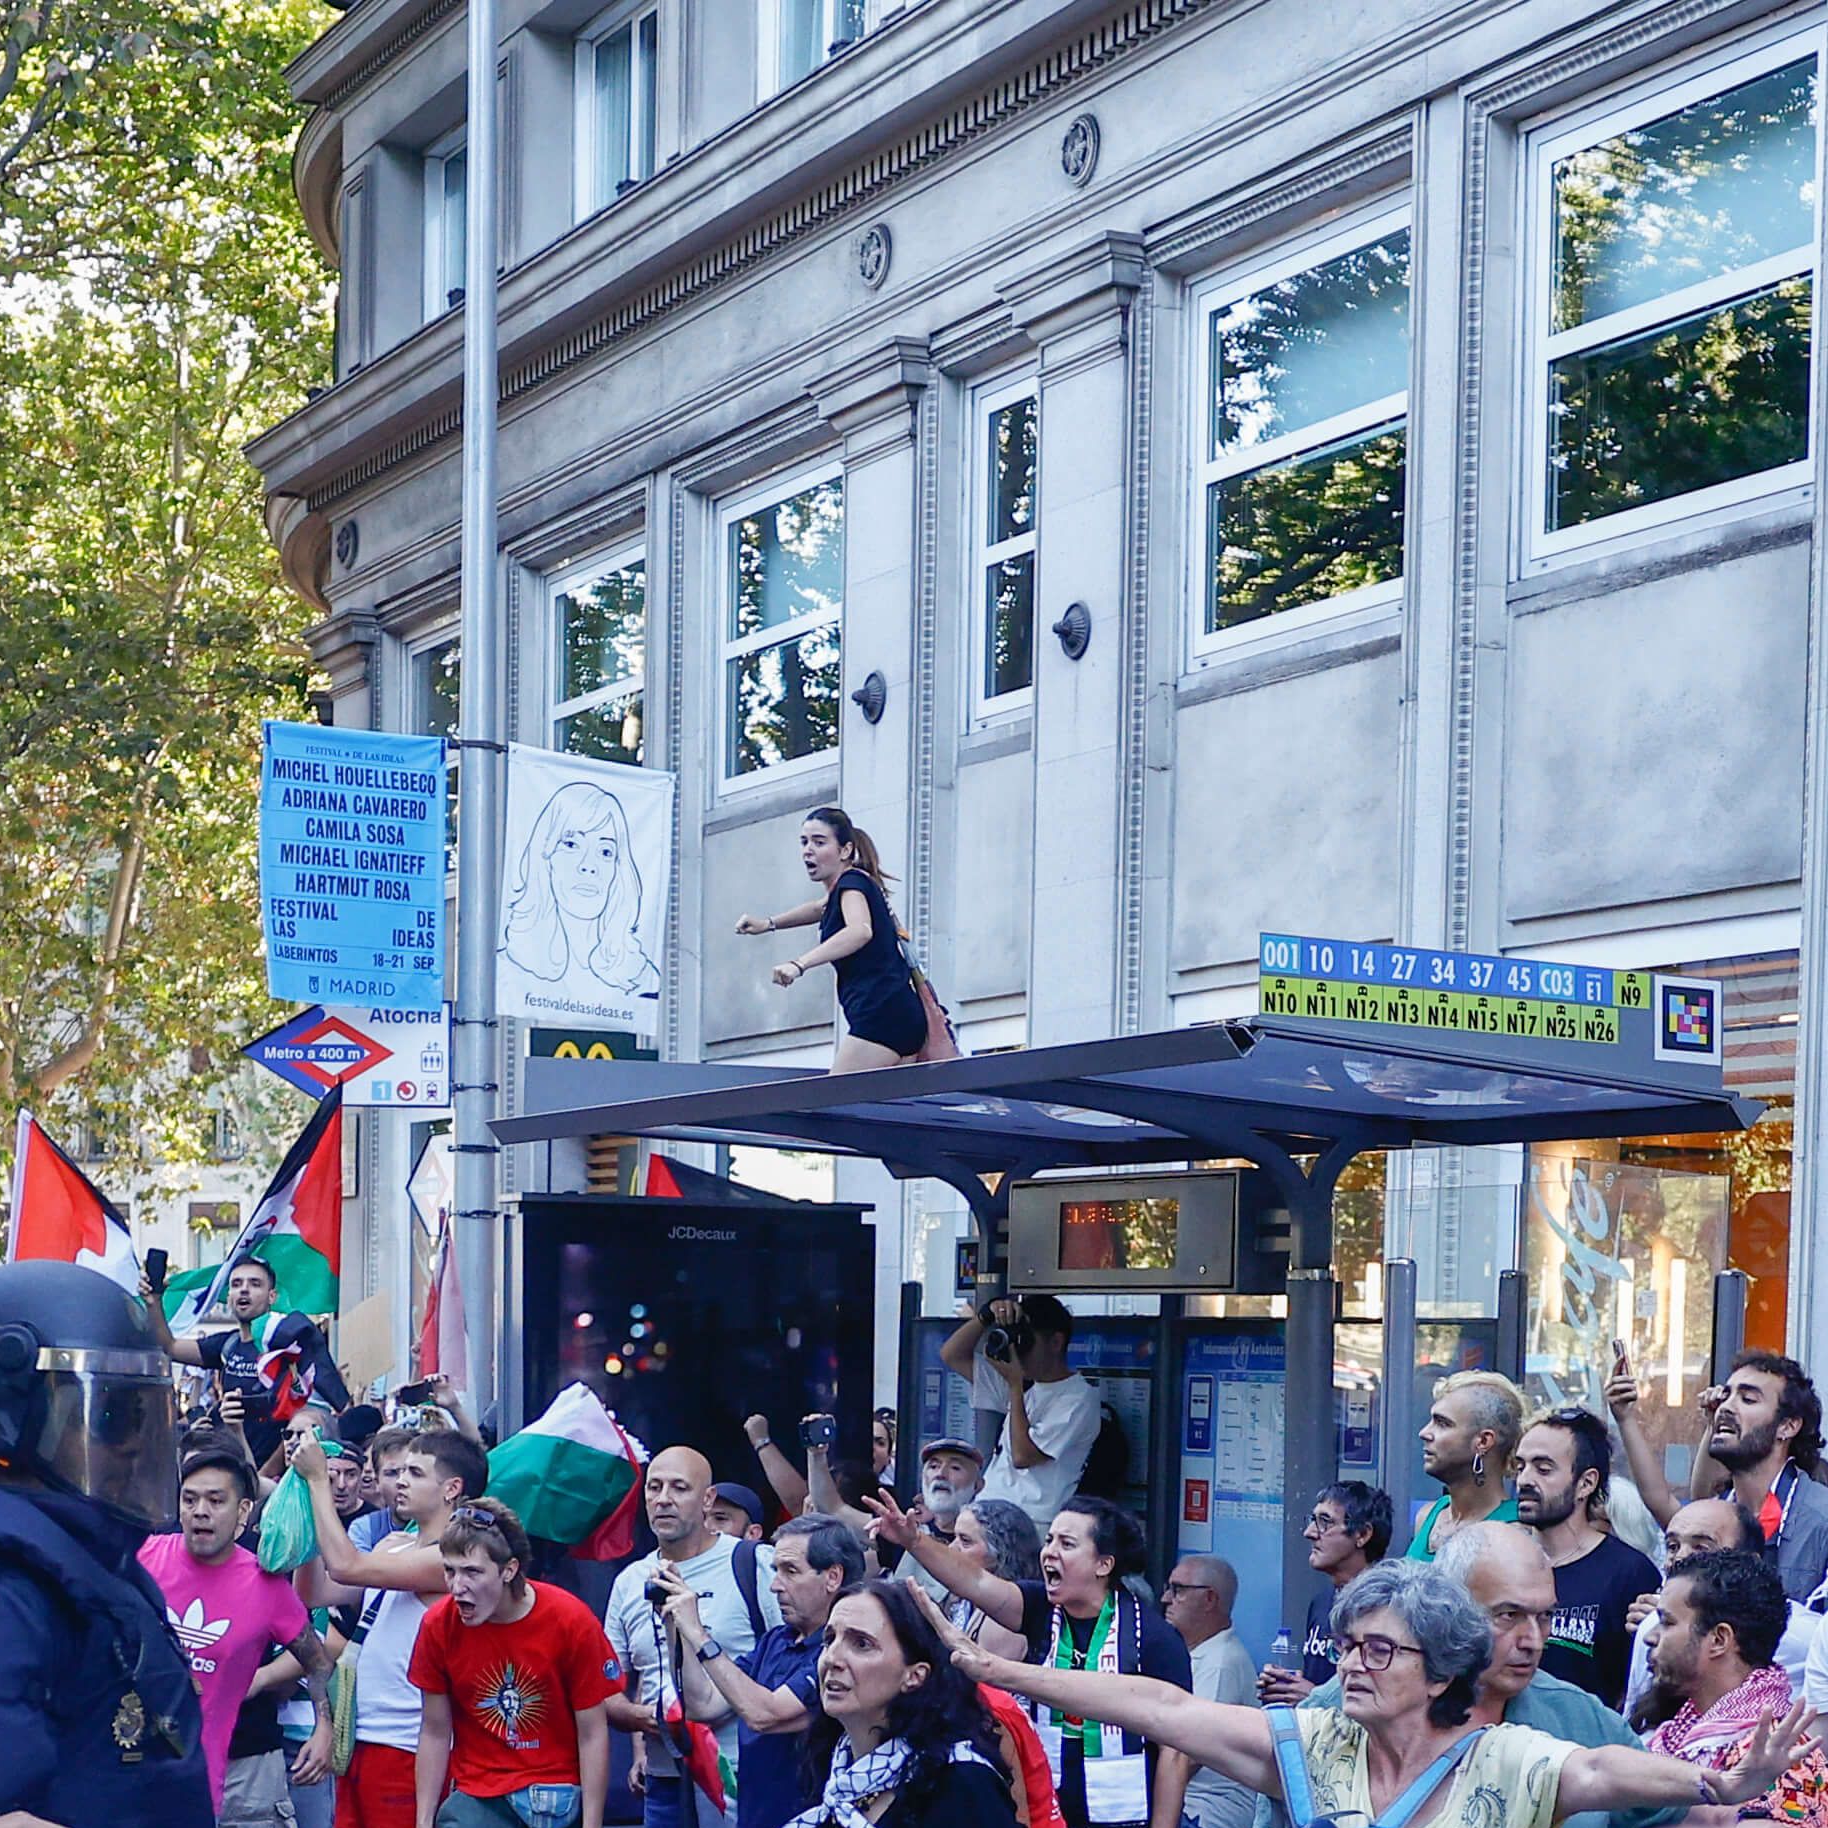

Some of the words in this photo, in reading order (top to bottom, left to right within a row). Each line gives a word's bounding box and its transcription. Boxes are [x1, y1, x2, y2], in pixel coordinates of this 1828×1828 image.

[306, 745, 343, 758] FESTIVAL
[352, 751, 364, 760] DE
[273, 758, 329, 784] MICHEL
[334, 765, 437, 798] HOUELLEBECQ
[282, 787, 348, 814] ADRIANA
[353, 794, 427, 821] CAVARERO
[306, 817, 361, 842] CAMILA
[366, 823, 405, 846] SOSA
[280, 844, 349, 868] MICHAEL
[354, 850, 426, 875] IGNATIEFF
[295, 872, 369, 898] HARTMUT
[374, 879, 411, 902] ROSA
[271, 898, 338, 921] FESTIVAL
[417, 910, 436, 929] DE
[272, 918, 296, 938] LAS
[392, 929, 435, 949] IDEAS
[274, 944, 338, 963] LABERINTOS
[413, 956, 435, 970] SEP
[330, 979, 396, 997] MADRID
[1263, 941, 1299, 969] 001
[1310, 945, 1334, 973] 10
[1351, 949, 1375, 976] 14
[1391, 953, 1417, 981] 27
[1430, 957, 1456, 985] 34
[1469, 961, 1494, 989] 37
[1507, 965, 1531, 992] 45
[1540, 969, 1573, 997] C03
[1586, 981, 1602, 1002] E1
[1621, 985, 1641, 1006] N9
[1264, 991, 1297, 1013] N10
[1307, 995, 1337, 1017] N11
[1347, 998, 1379, 1020] N12
[1387, 1002, 1419, 1024] N13
[1428, 1005, 1458, 1027] N14
[1467, 1009, 1498, 1031] N15
[1507, 1013, 1537, 1034] N17
[1546, 1017, 1576, 1038] N25
[1585, 1020, 1614, 1042] N26
[264, 1047, 304, 1059] Metro
[307, 1050, 315, 1059] a
[321, 1047, 345, 1060] 400
[347, 1050, 361, 1059] m
[667, 1226, 737, 1240] JCDecaux
